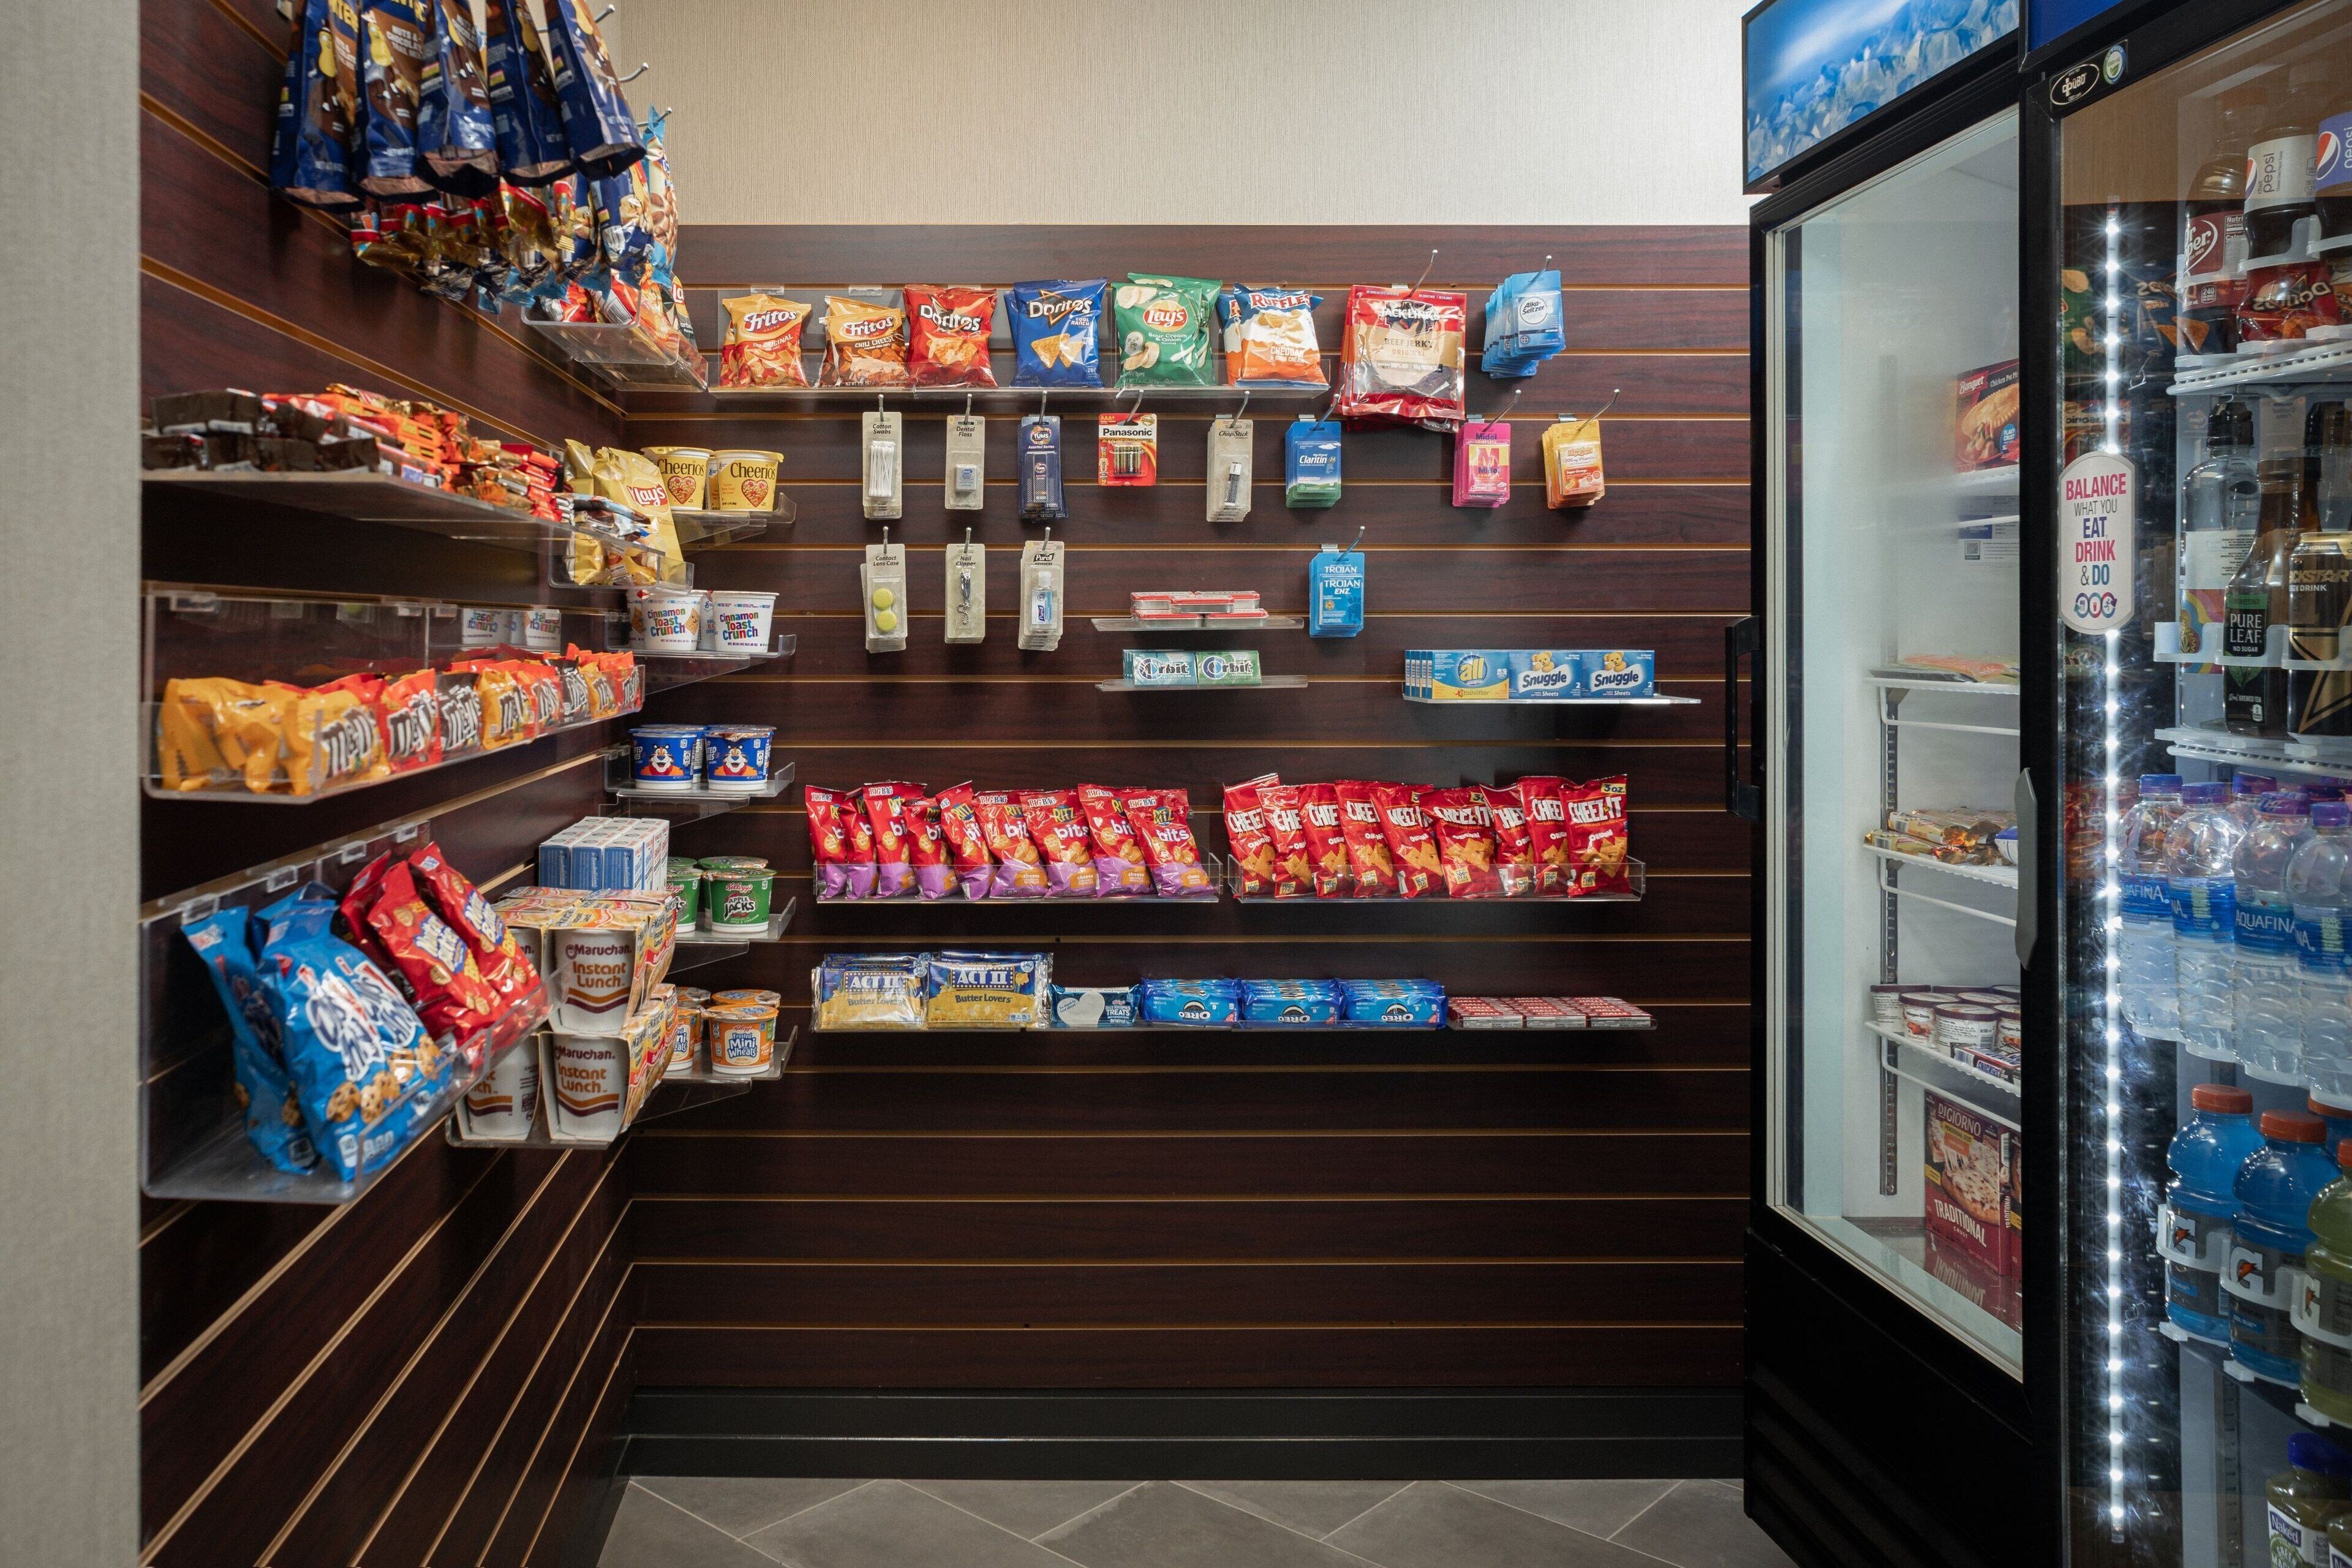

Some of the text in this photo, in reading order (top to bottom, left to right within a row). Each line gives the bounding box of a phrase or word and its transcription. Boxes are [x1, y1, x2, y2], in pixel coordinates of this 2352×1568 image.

[2263, 153, 2276, 193] pepsi
[1029, 299, 1093, 318] Doritos
[1250, 294, 1311, 309] RUFFLES
[1148, 306, 1185, 326] Lay's
[1522, 305, 1544, 314] Seltzer
[744, 311, 797, 332] Fritos
[920, 304, 981, 331] Doritos
[843, 317, 894, 337] Fritos
[763, 334, 793, 348] ORIGINAL
[872, 335, 894, 346] CHEESE
[1406, 339, 1433, 348] JERKY
[1271, 346, 1305, 356] CHEDDAR
[1991, 377, 2005, 387] Chicken
[1300, 455, 1327, 464] Claritin
[658, 459, 704, 477] Cheerios
[730, 462, 775, 480] Cheerios
[2066, 473, 2127, 500] BALANCE
[635, 484, 667, 507] Lay's
[2075, 498, 2117, 516] WHAT YOU
[2075, 540, 2116, 563] DRINK
[2081, 564, 2109, 586] & DO
[2290, 570, 2349, 582] CKSTAR
[654, 616, 679, 628] Toast
[726, 619, 752, 631] Toast
[2230, 614, 2262, 628] PURE
[650, 624, 685, 636] Crunch
[723, 626, 758, 640] Crunch
[2230, 630, 2261, 643] LEAF
[1139, 658, 1189, 680] Orbit
[1202, 656, 1253, 679] Orbit
[1460, 657, 1485, 681] all
[1523, 671, 1566, 688] Snuggle
[1594, 670, 1638, 687] Snuggle
[869, 786, 893, 796] BIG BAG
[1028, 797, 1057, 807] BIG BAG
[1129, 797, 1156, 809] BIG BAG
[952, 804, 974, 820] RITZ
[1005, 805, 1023, 817] RIT
[1052, 807, 1075, 823] RITZ
[1153, 807, 1174, 824] RITZ
[1055, 826, 1089, 840] bits
[1111, 820, 1136, 835] bit
[1156, 829, 1190, 842] bits
[726, 883, 753, 892] Kellogg's
[724, 902, 756, 921] JACKS
[2236, 911, 2296, 933] AQUAFINA
[573, 961, 626, 975] Instant
[577, 974, 621, 988] Lunch
[850, 976, 880, 989] ACT
[957, 970, 1008, 984] ACT II
[847, 998, 876, 1006] Butter
[955, 993, 1011, 1003] Butter Lovers
[1278, 1015, 1311, 1023] OREO
[1381, 1013, 1414, 1023] OREO
[729, 1038, 756, 1049] Mini
[728, 1047, 757, 1058] Wheats
[558, 1063, 606, 1080] Instant
[560, 1077, 602, 1094] Lunch
[1934, 1199, 1986, 1247] TRADITIONAL
[1953, 1226, 1967, 1238] CRUST
[2272, 1515, 2297, 1544] Naked
